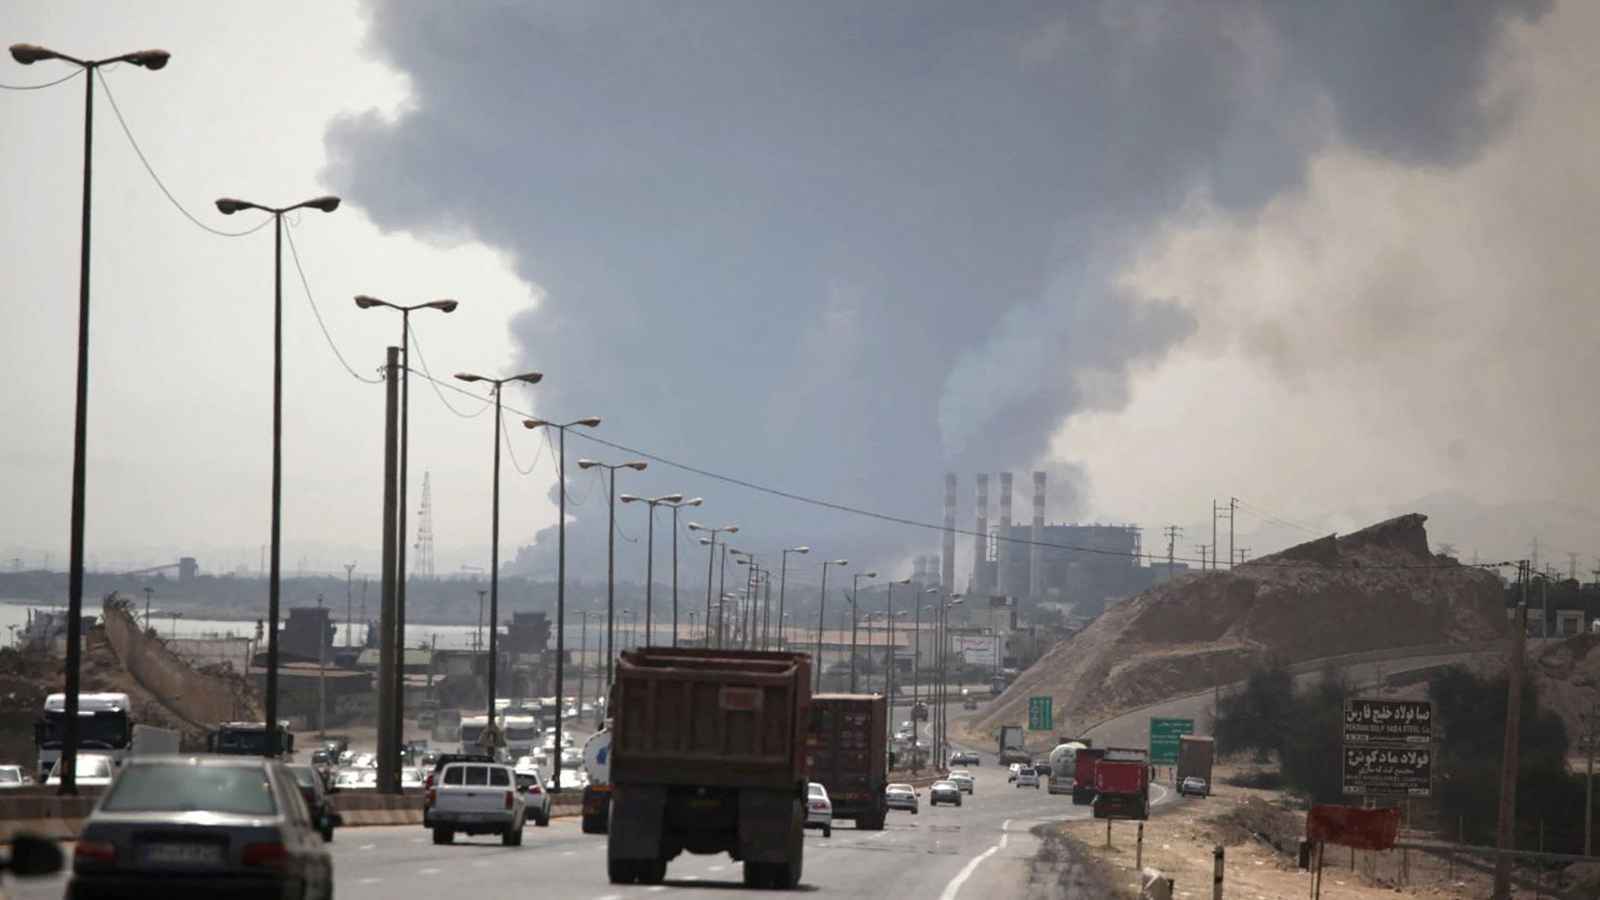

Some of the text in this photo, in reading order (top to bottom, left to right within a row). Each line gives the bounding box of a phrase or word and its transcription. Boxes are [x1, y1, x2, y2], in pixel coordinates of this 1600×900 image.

[1346, 703, 1371, 722] فارس
[1372, 704, 1393, 724] خلیج
[1394, 703, 1414, 724] فولاد
[1400, 751, 1429, 769] فولاد
